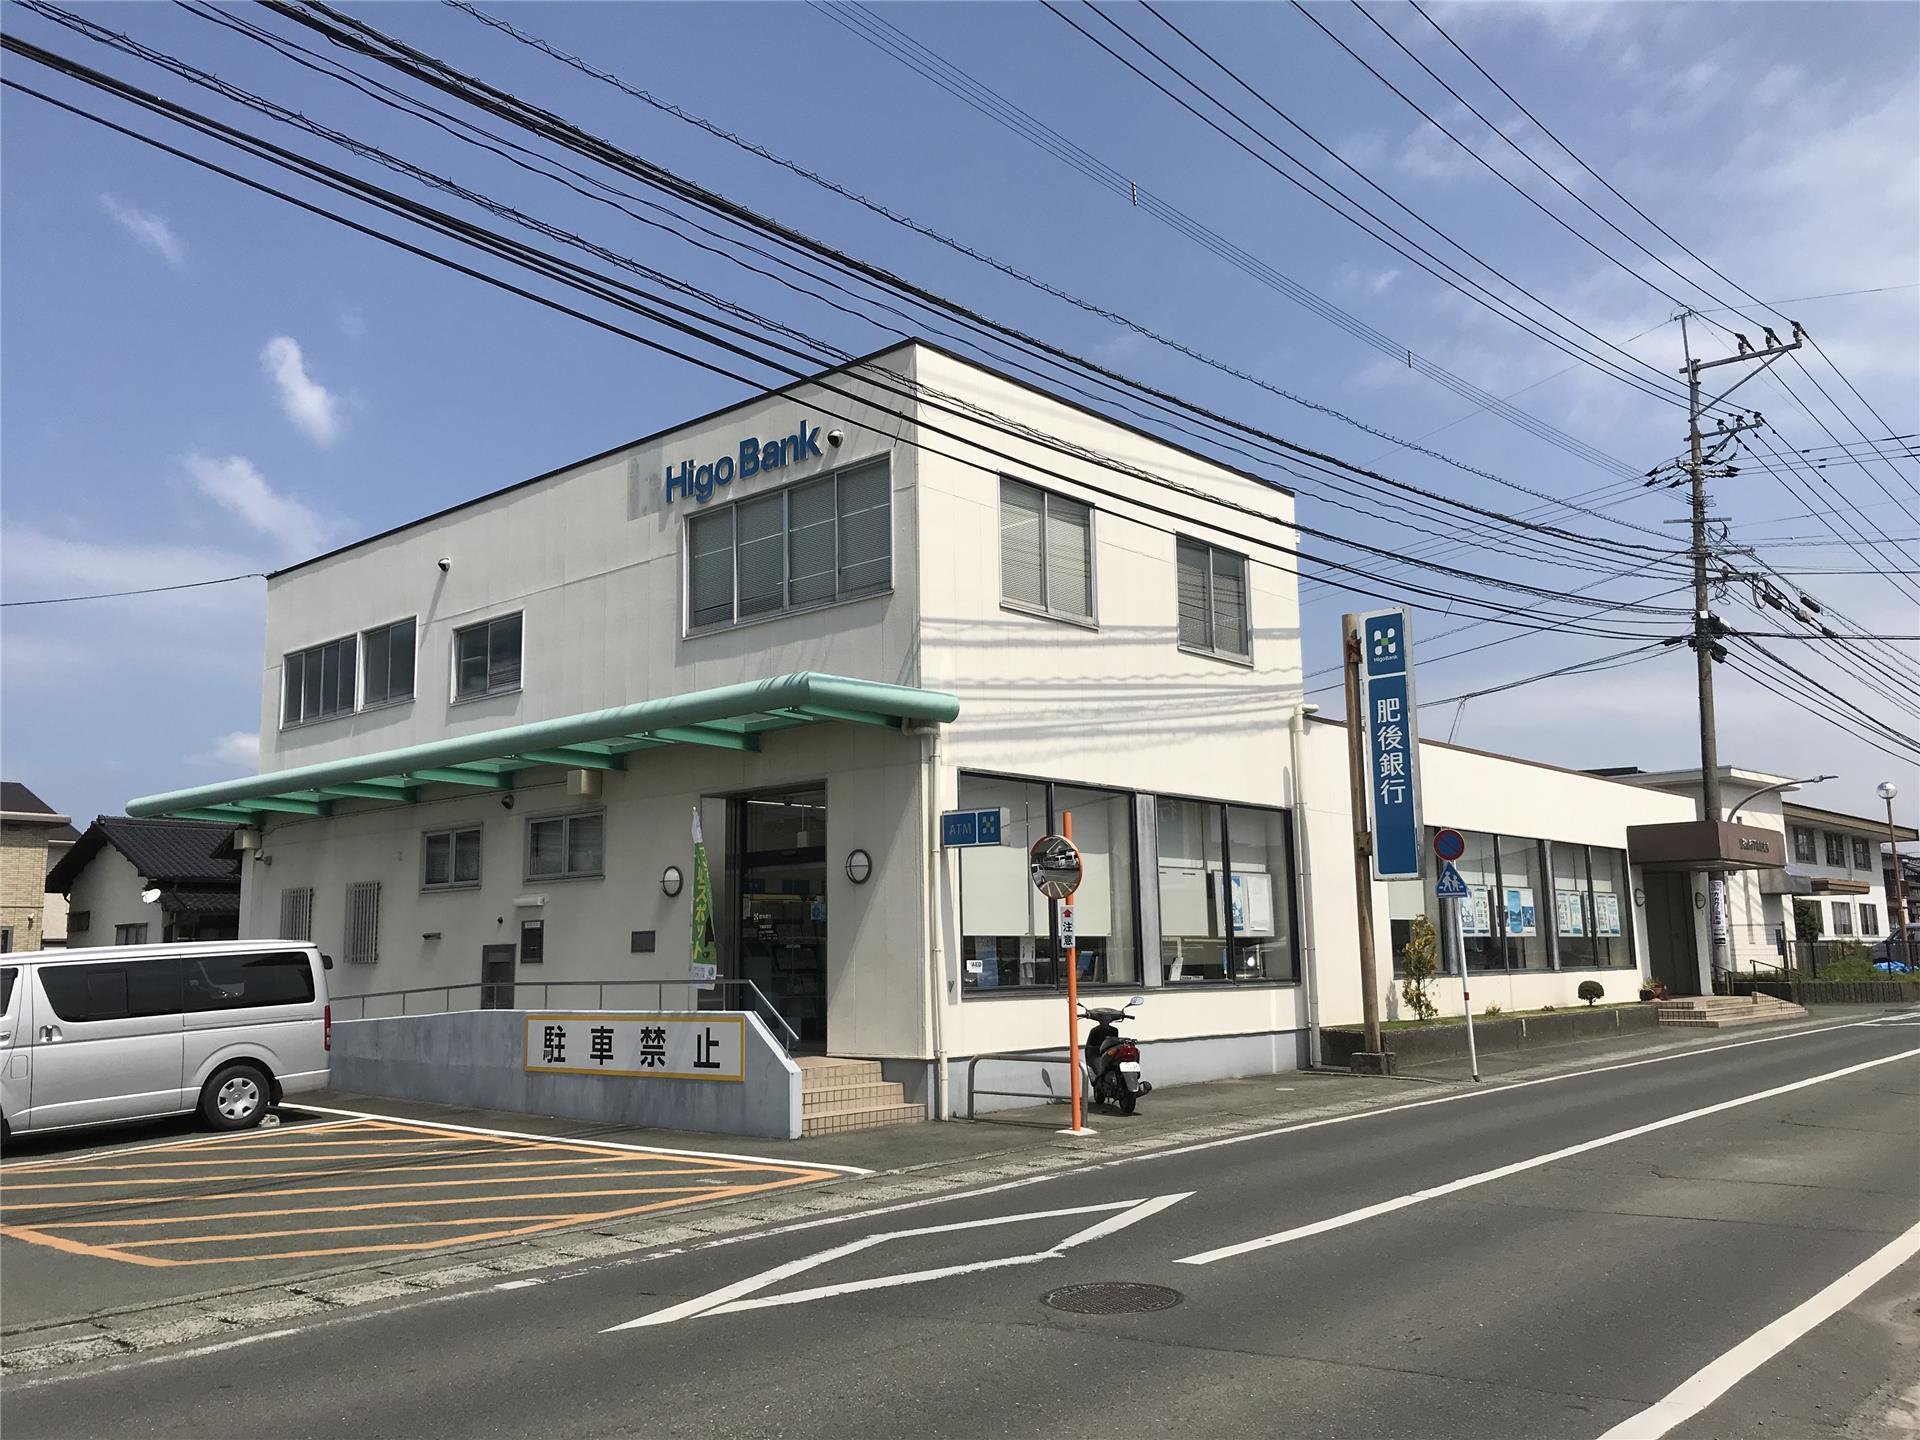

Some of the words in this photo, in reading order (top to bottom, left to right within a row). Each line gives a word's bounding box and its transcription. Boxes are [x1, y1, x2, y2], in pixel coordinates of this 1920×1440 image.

[666, 459, 736, 504] Higo
[739, 419, 823, 480] Bank
[1377, 697, 1406, 805] 肥後銀行
[949, 823, 972, 835] ATM
[1063, 921, 1074, 946] 注意
[542, 1025, 721, 1069] 駐車禁止
